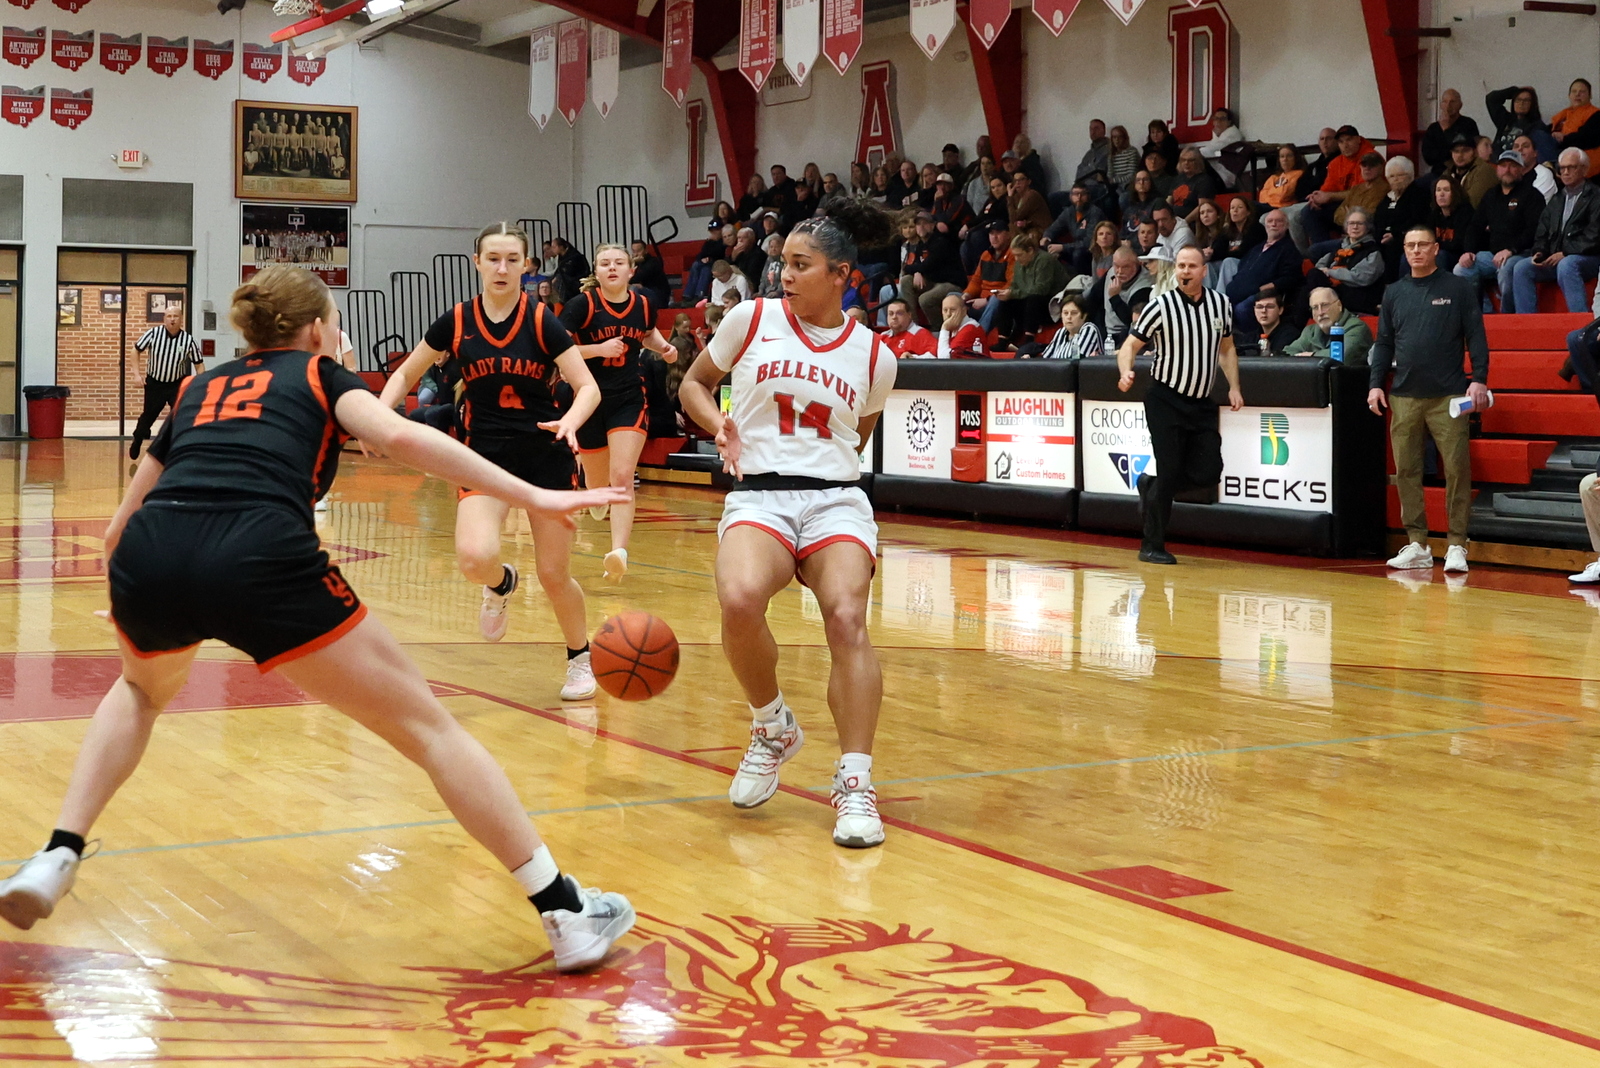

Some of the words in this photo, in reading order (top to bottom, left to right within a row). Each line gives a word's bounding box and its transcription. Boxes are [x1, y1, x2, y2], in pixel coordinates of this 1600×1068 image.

[123, 150, 140, 162] EXIT
[590, 325, 617, 342] LADY
[620, 325, 645, 343] RAM
[462, 357, 496, 382] LADY
[501, 357, 546, 380] RAMS
[756, 360, 857, 411] BELLEVUE
[193, 370, 275, 427] 12
[995, 397, 1065, 416] LAUGHLIN
[773, 391, 833, 440] 14
[960, 410, 981, 427] POSS
[1036, 418, 1063, 427] LIVING
[1091, 407, 1149, 429] CROGH
[1016, 468, 1041, 479] Custom
[1042, 469, 1066, 480] Homes
[1224, 475, 1327, 504] BECK'S
